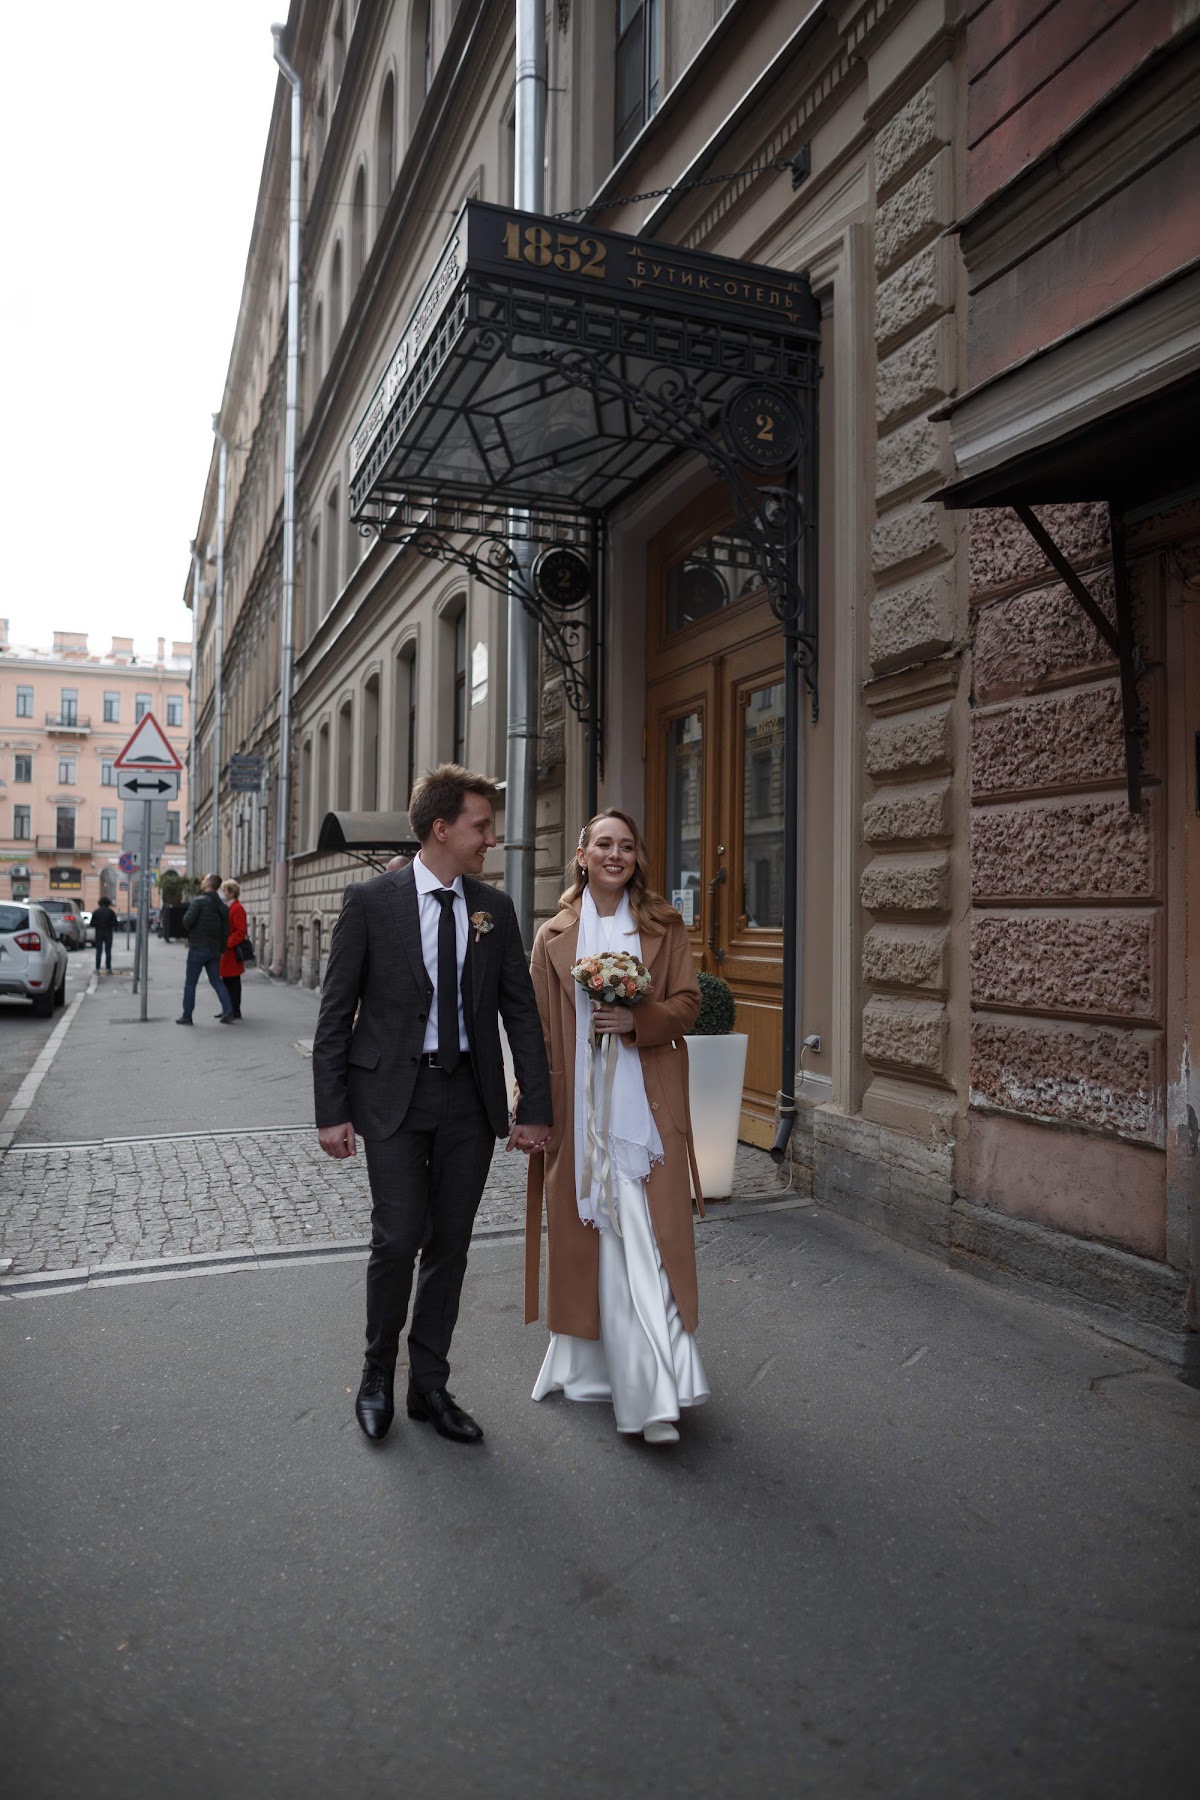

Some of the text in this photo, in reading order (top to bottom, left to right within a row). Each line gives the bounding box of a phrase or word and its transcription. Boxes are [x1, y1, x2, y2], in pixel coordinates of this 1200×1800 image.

[502, 221, 607, 279] 1852
[636, 260, 794, 309] БУТИК-ОТЕЛЬ
[756, 414, 774, 442] 2
